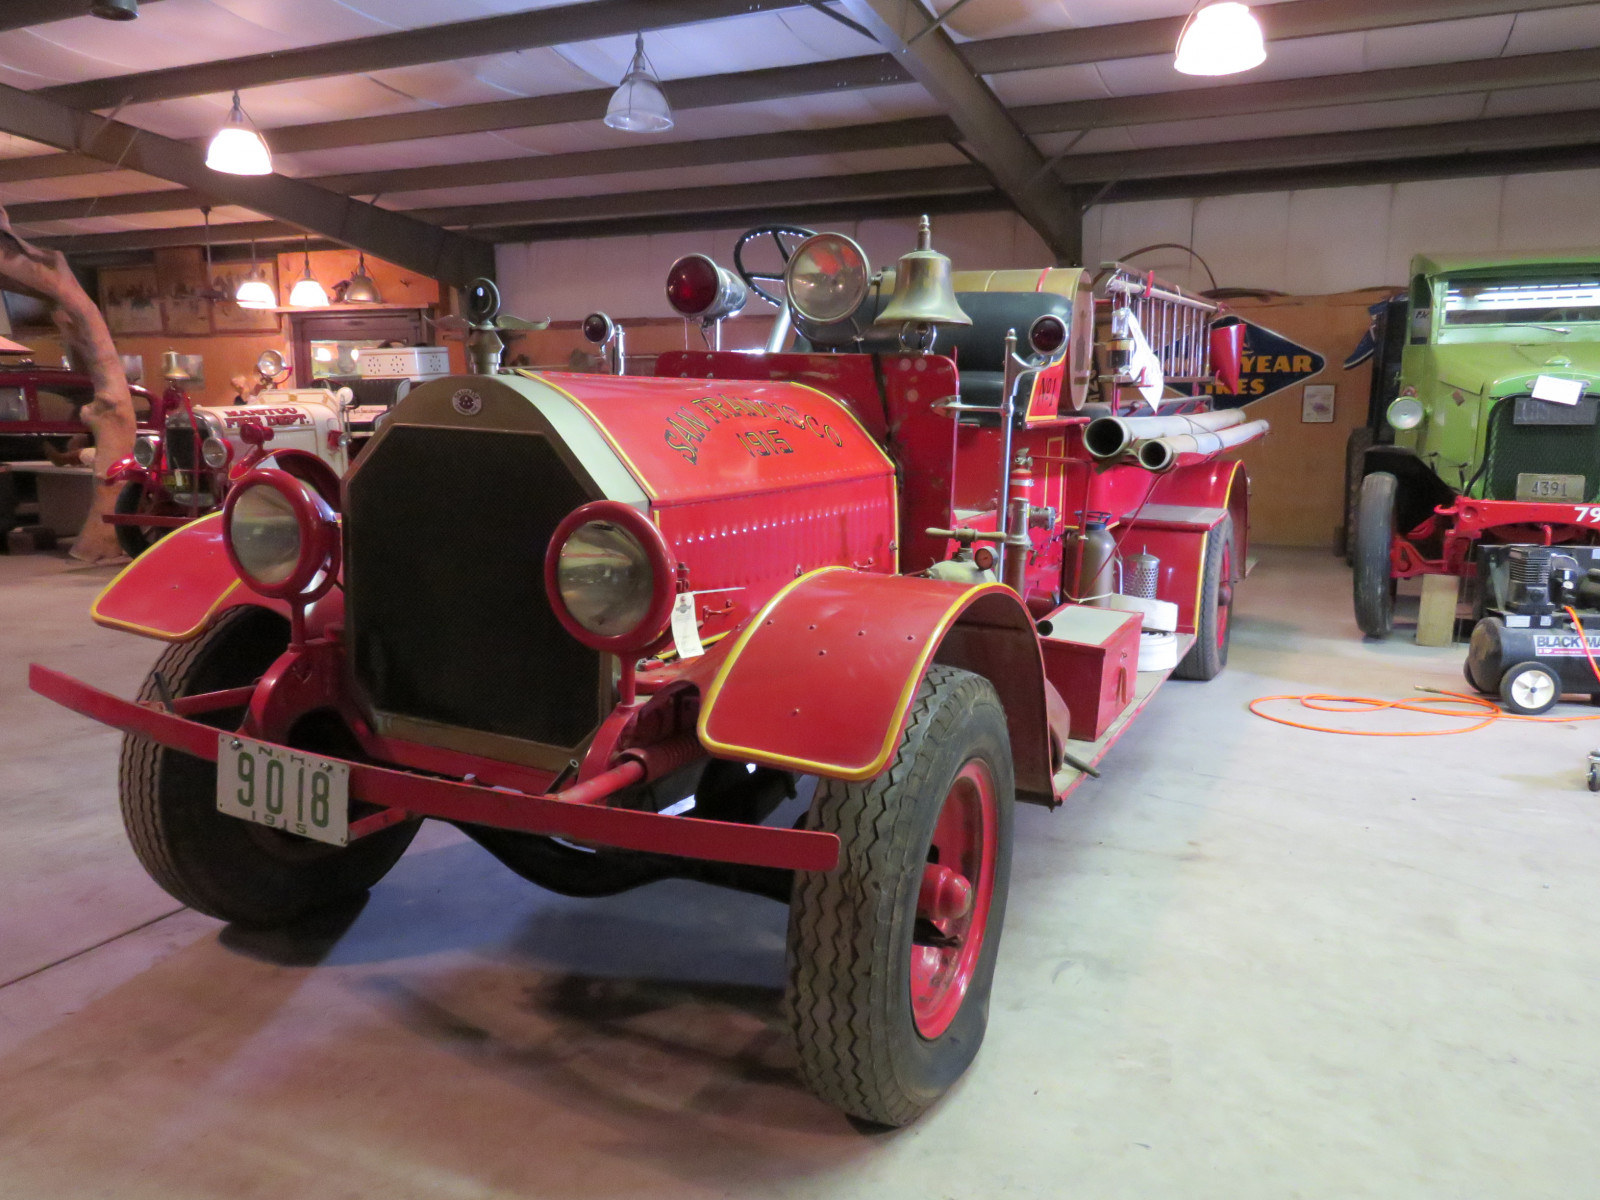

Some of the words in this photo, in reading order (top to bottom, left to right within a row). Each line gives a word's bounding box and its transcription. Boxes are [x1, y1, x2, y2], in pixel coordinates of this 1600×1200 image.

[223, 407, 298, 417] MANITOU
[224, 416, 263, 429] FIRE
[265, 414, 310, 426] DEPT.
[665, 406, 711, 466] SAN
[691, 393, 844, 448] FRANCISCO
[736, 429, 794, 458] 1915
[1531, 481, 1567, 497] 4391
[1537, 636, 1580, 648] BLACK
[237, 751, 330, 828] 9018
